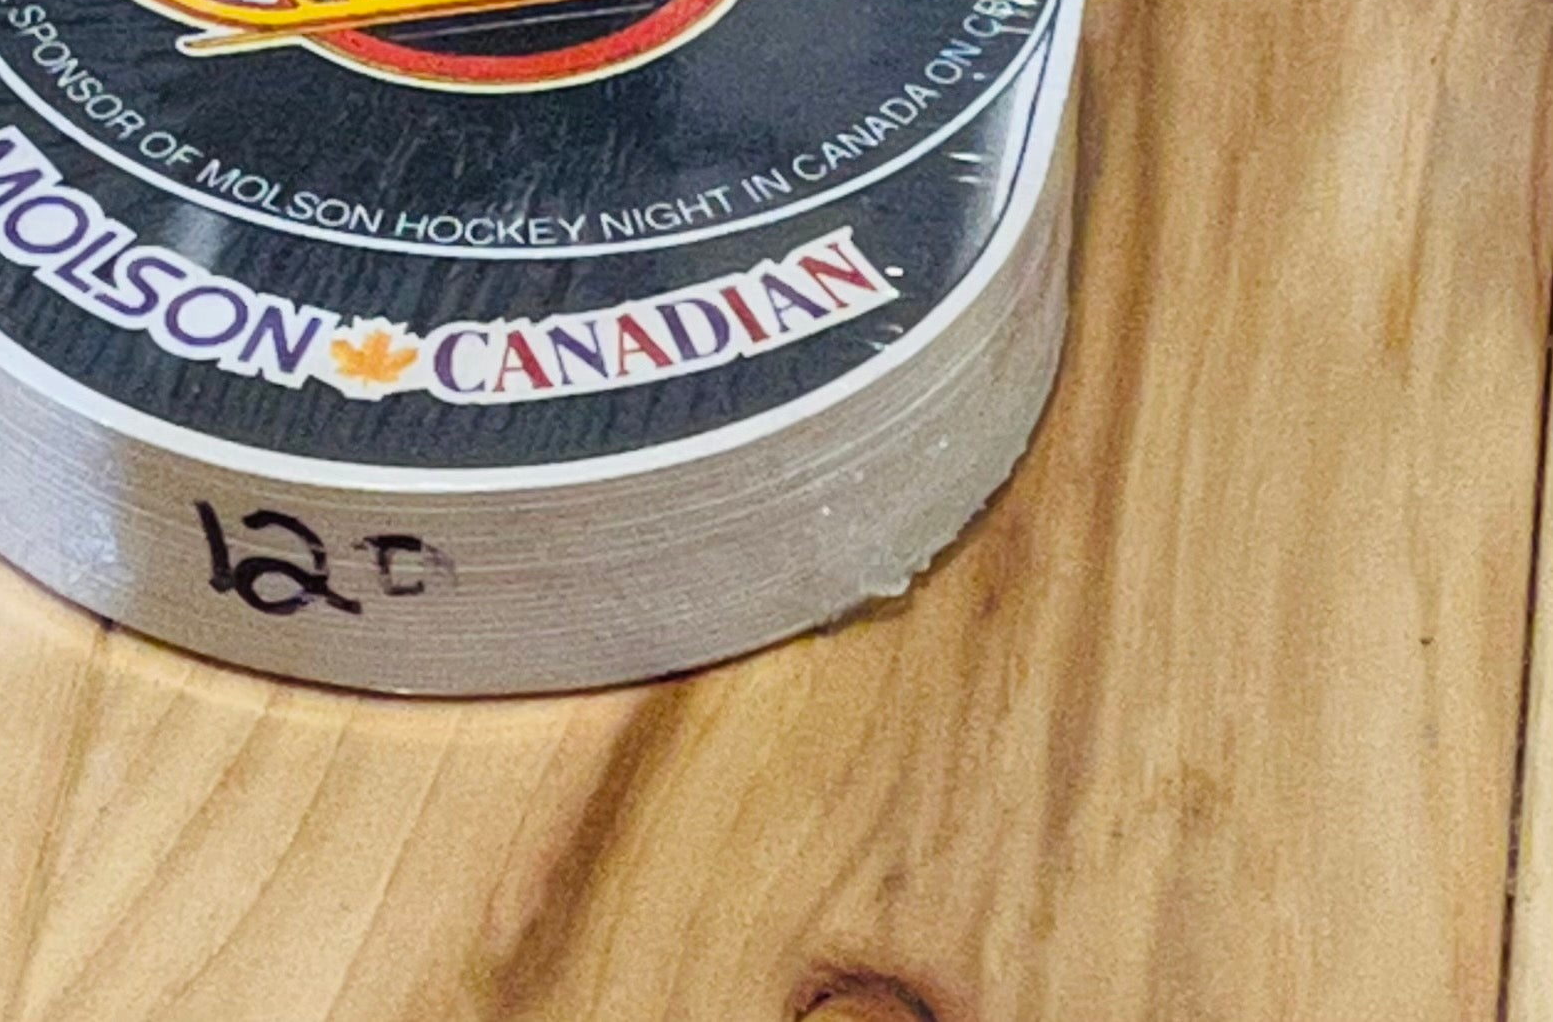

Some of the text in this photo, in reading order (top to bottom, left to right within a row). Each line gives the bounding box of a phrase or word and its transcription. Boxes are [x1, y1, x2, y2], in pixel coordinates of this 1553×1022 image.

[8, 4, 146, 140] SPONSOR
[139, 131, 204, 167] OF
[194, 158, 385, 235] MOLSON
[392, 210, 588, 246] HOCKEY
[598, 184, 734, 242] NIGHT
[741, 167, 793, 205] IN
[791, 82, 941, 183] CANADA
[925, 38, 983, 85] ON
[432, 241, 878, 394] CANADIAN
